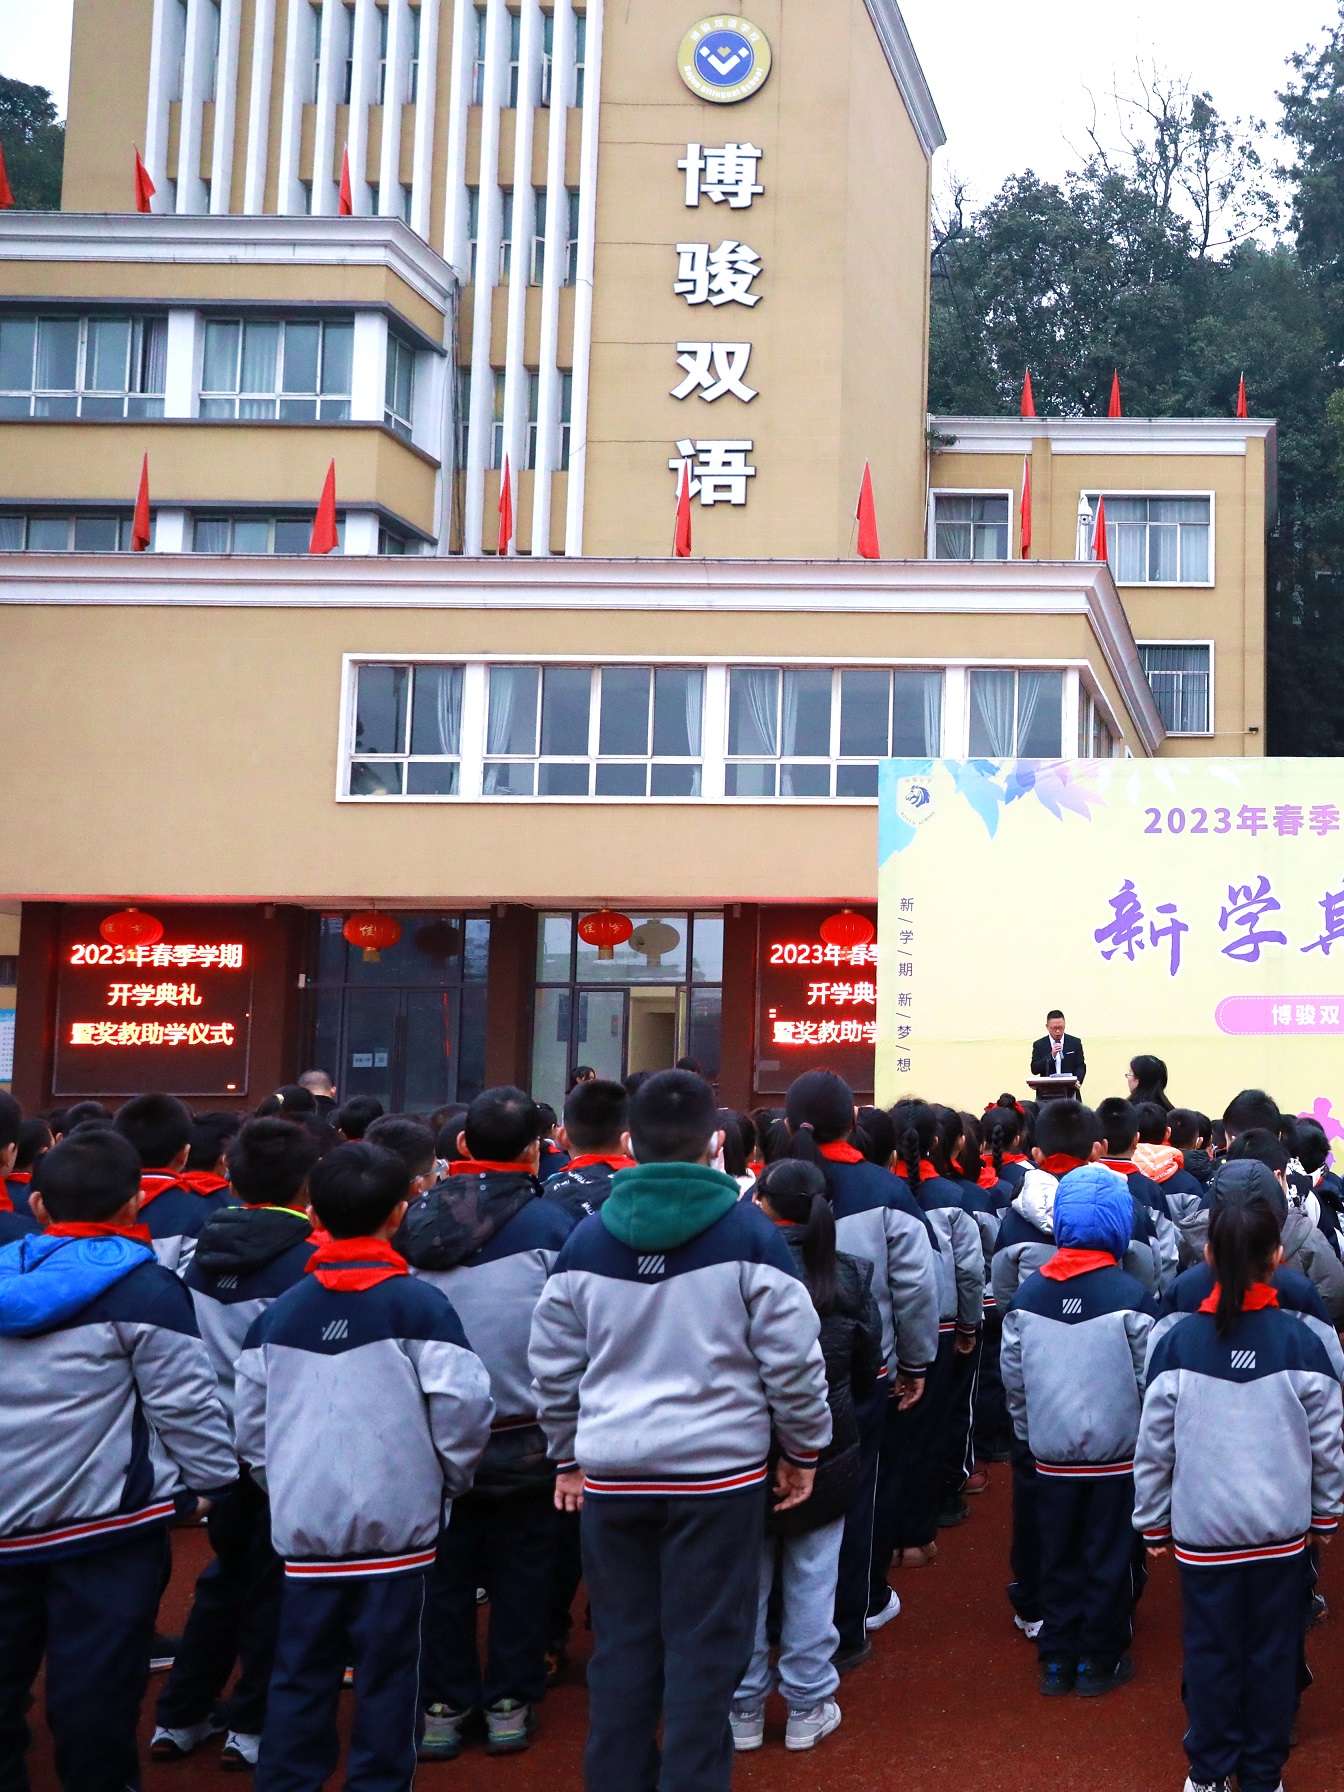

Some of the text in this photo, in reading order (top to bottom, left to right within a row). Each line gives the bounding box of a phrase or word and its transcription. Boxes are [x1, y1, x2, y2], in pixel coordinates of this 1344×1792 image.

[668, 142, 764, 506] 博骏双语
[69, 943, 243, 968] 2023年春季学期
[107, 982, 203, 1007] 开学典礼
[807, 981, 877, 1006] 开学典
